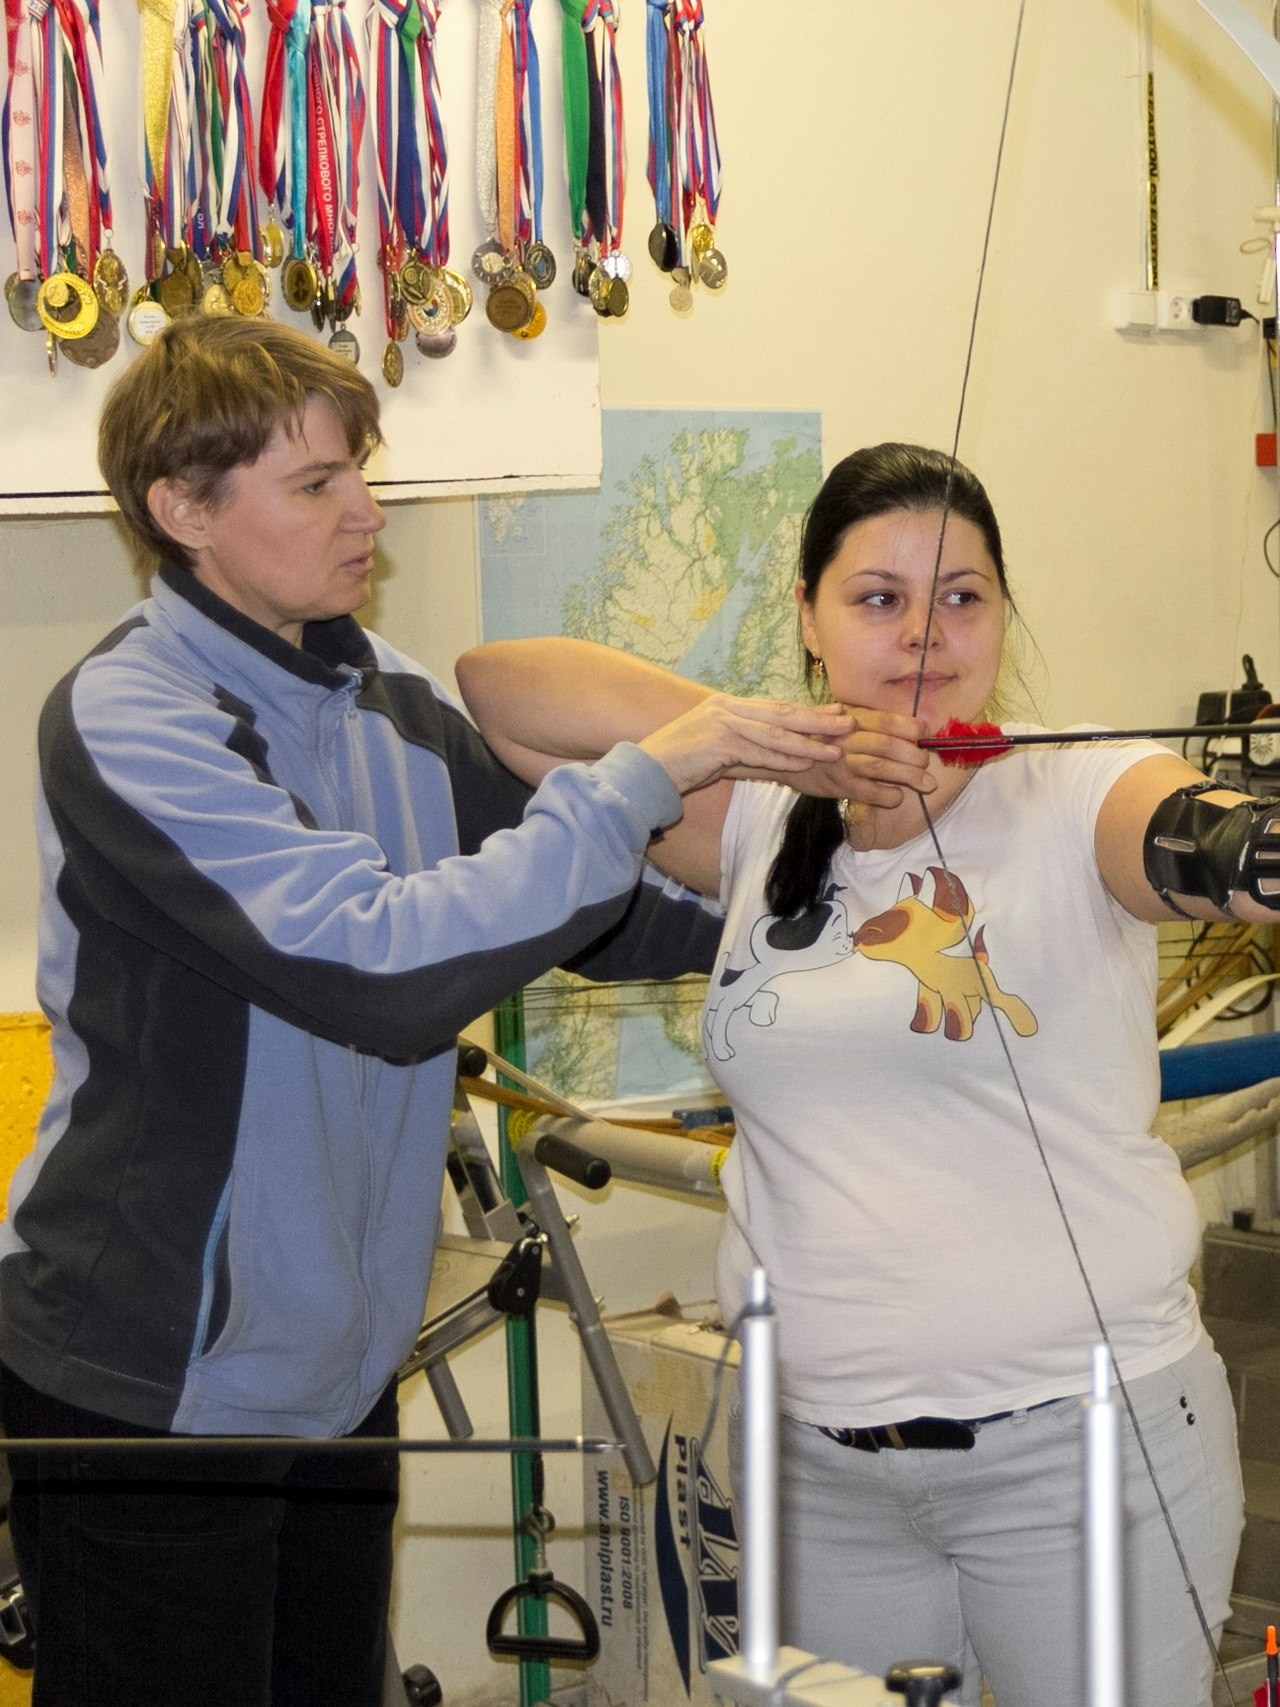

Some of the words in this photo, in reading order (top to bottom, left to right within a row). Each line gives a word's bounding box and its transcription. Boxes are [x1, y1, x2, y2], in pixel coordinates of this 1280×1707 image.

[315, 117, 333, 202] СТРЕЛКОВОГО
[1148, 98, 1159, 178] EASTON
[596, 1470, 615, 1627] www.aniplast.ru
[618, 1496, 631, 1522] ISO
[619, 1527, 633, 1610] 9001:2008
